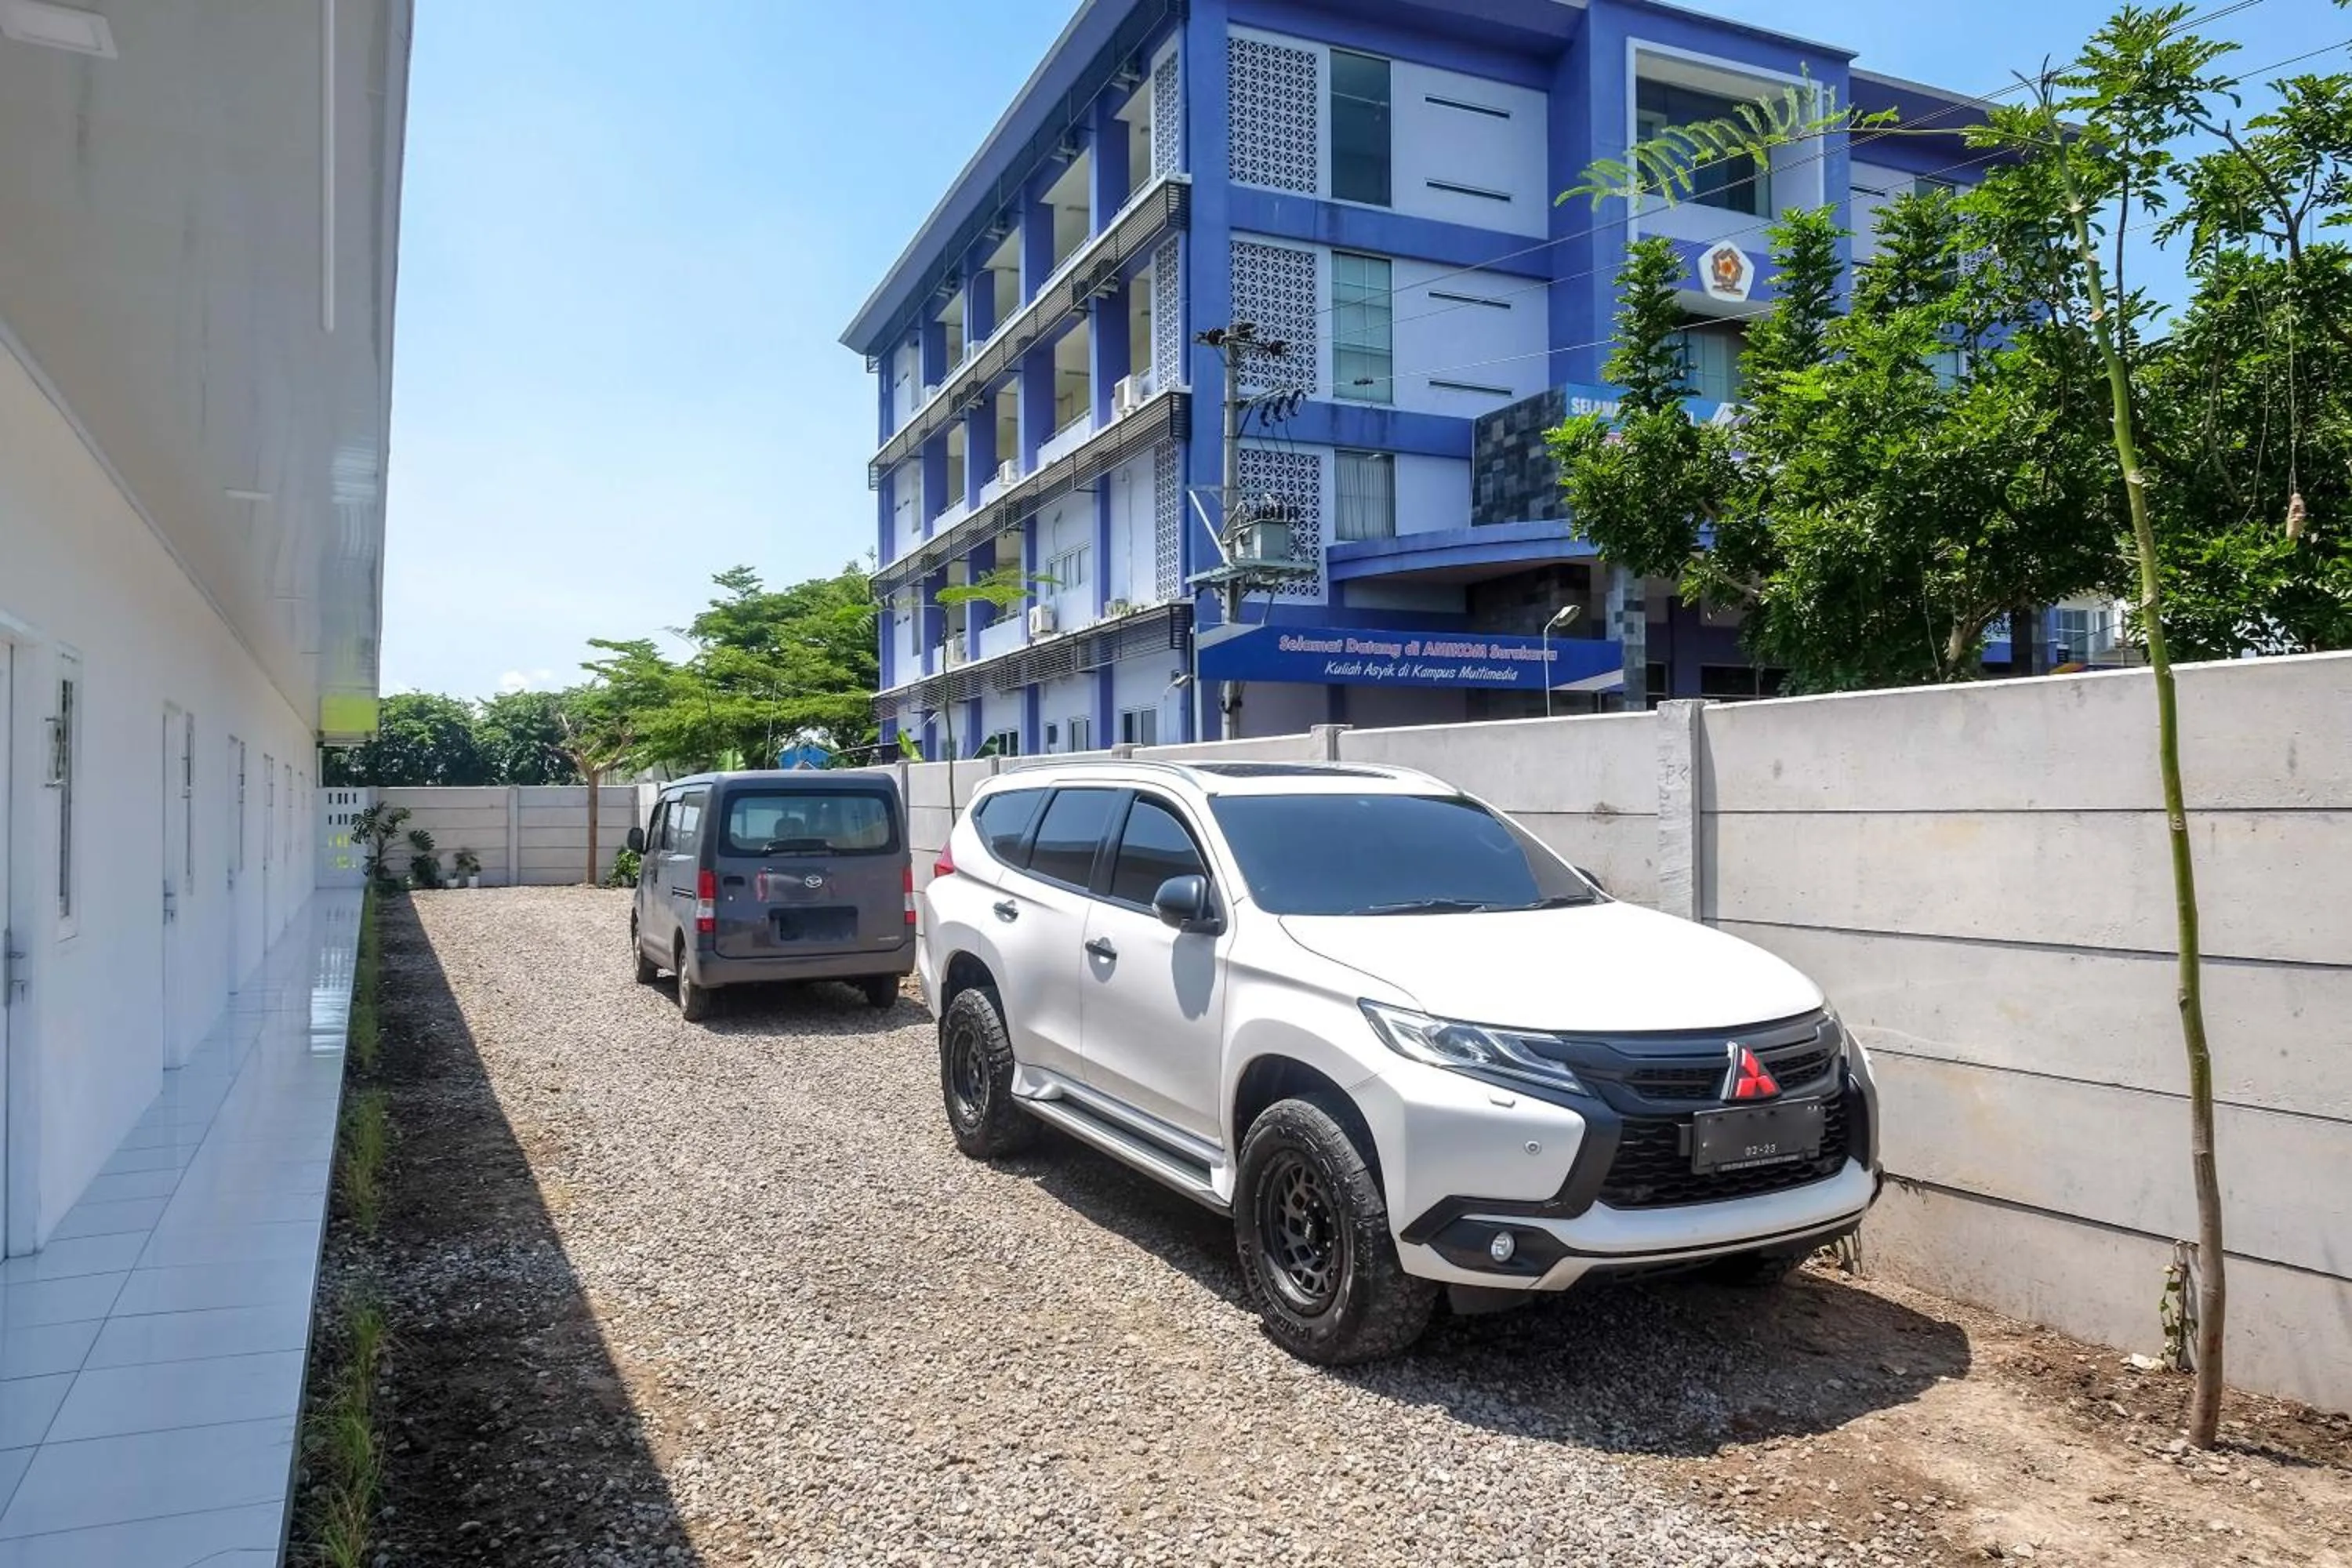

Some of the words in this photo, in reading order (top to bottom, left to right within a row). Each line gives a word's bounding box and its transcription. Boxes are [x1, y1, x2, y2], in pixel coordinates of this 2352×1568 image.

[1279, 634, 1342, 653] Selamat
[1345, 637, 1402, 659] Datang
[1404, 641, 1420, 656] di
[1422, 641, 1486, 659] AMIKOM
[1324, 660, 1362, 675] Kuliah
[1363, 662, 1394, 680] Asyik
[1398, 663, 1410, 677] di
[1411, 664, 1456, 681] Kampus
[1457, 666, 1518, 681] Multimedia
